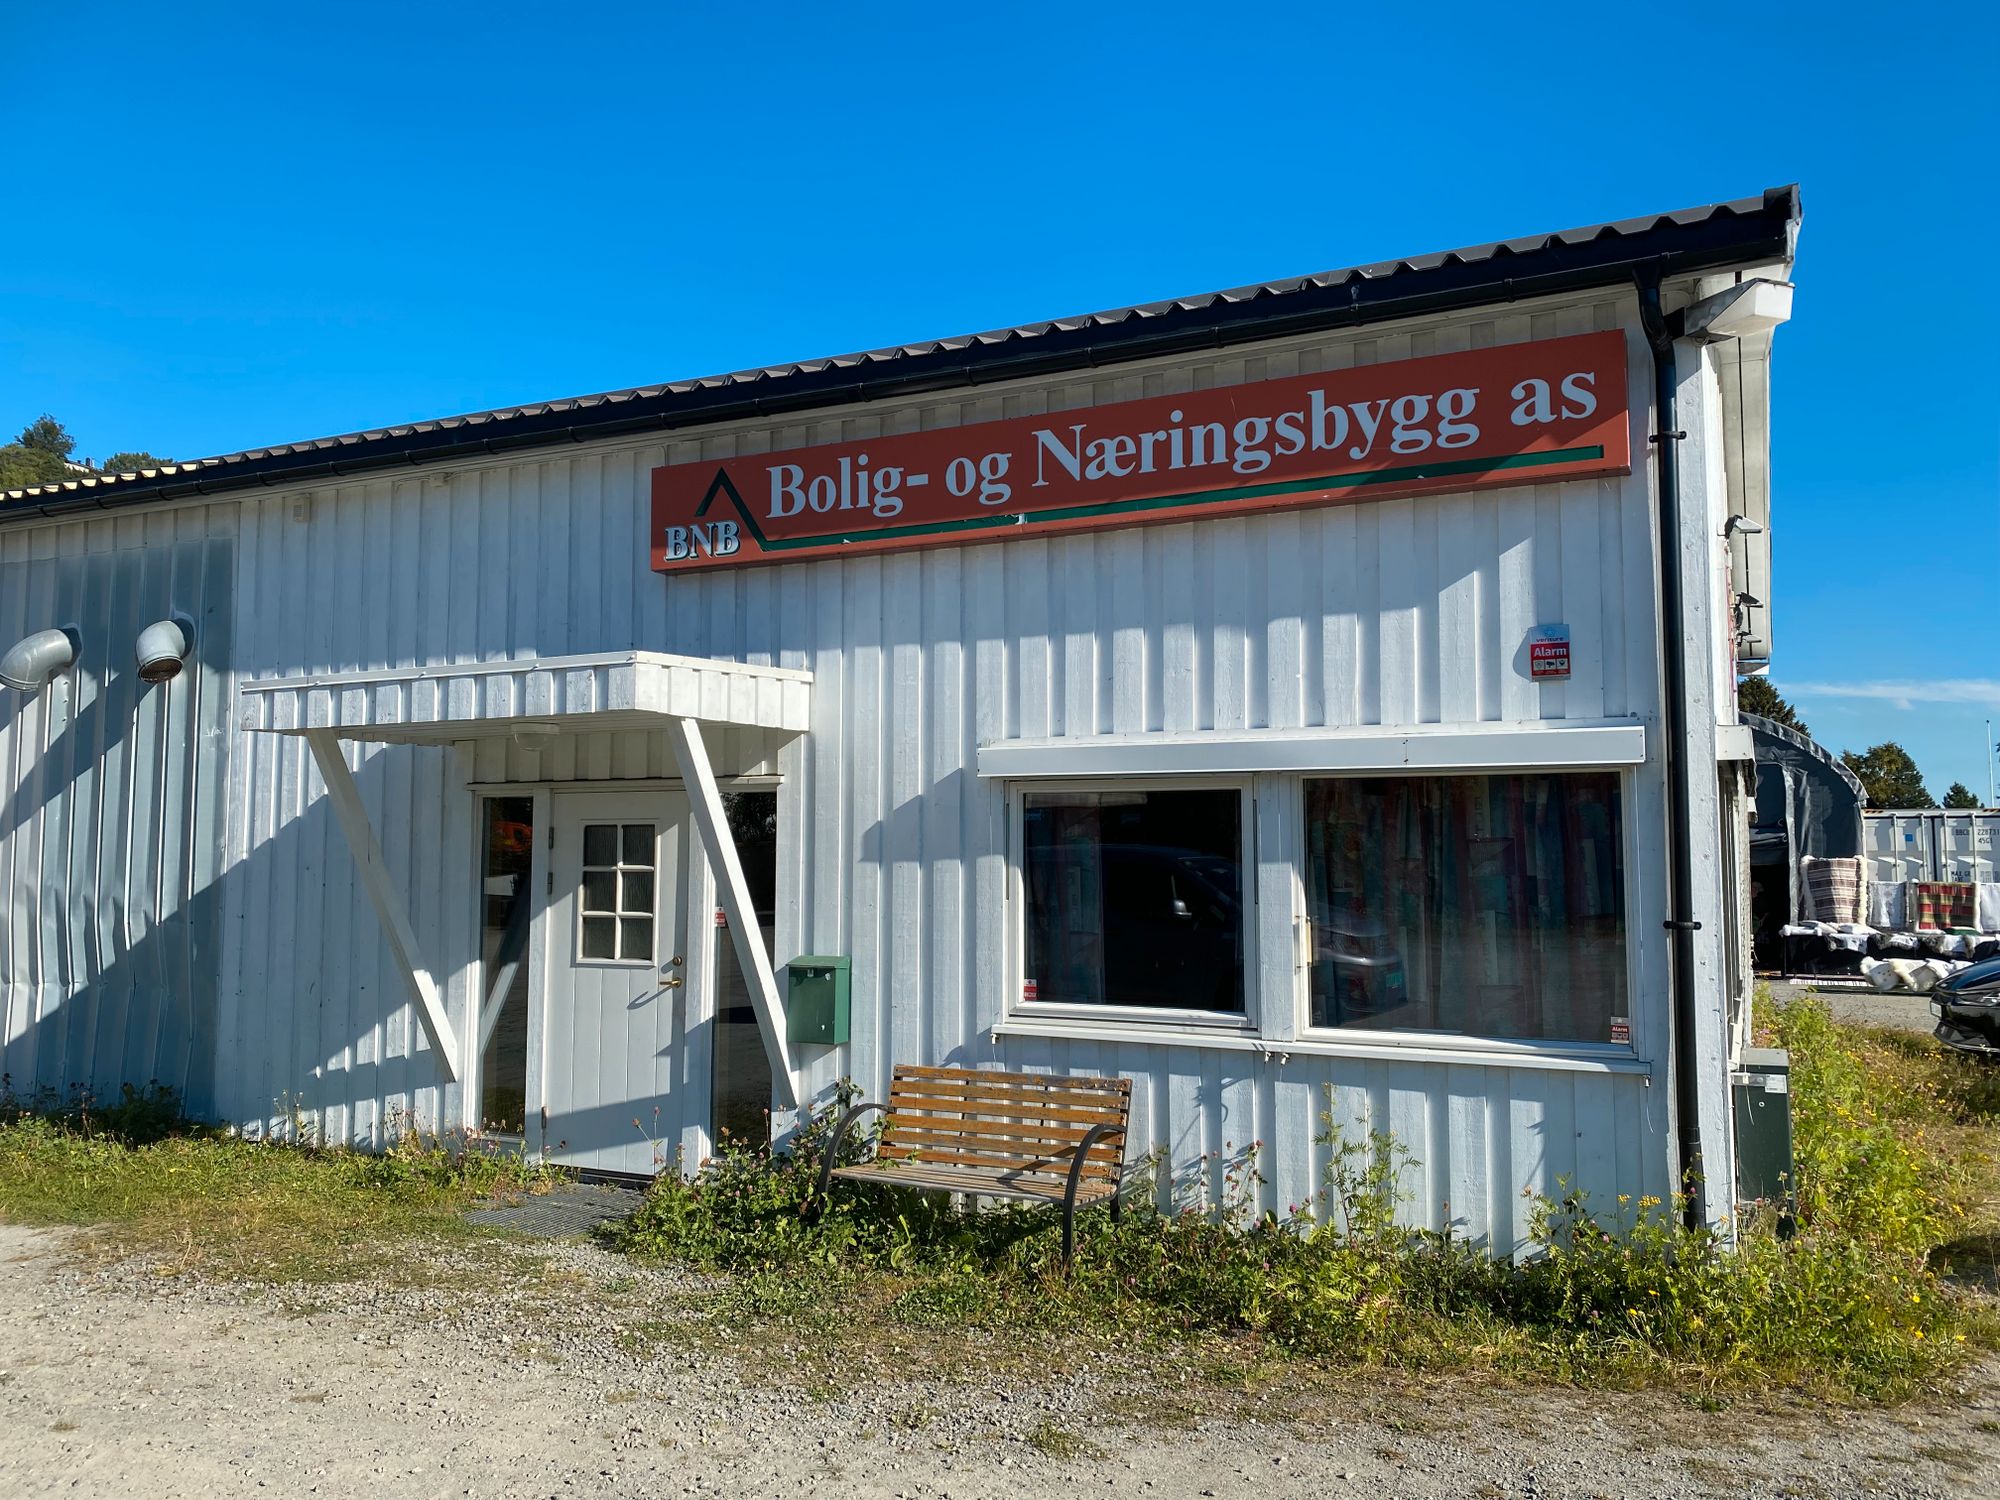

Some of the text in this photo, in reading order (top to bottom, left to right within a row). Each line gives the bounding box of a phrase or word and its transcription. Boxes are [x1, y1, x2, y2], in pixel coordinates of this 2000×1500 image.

[766, 371, 1598, 519] Bolig- og Næringsbygg as
[664, 519, 741, 561] BNB
[1534, 647, 1567, 657] Alarm
